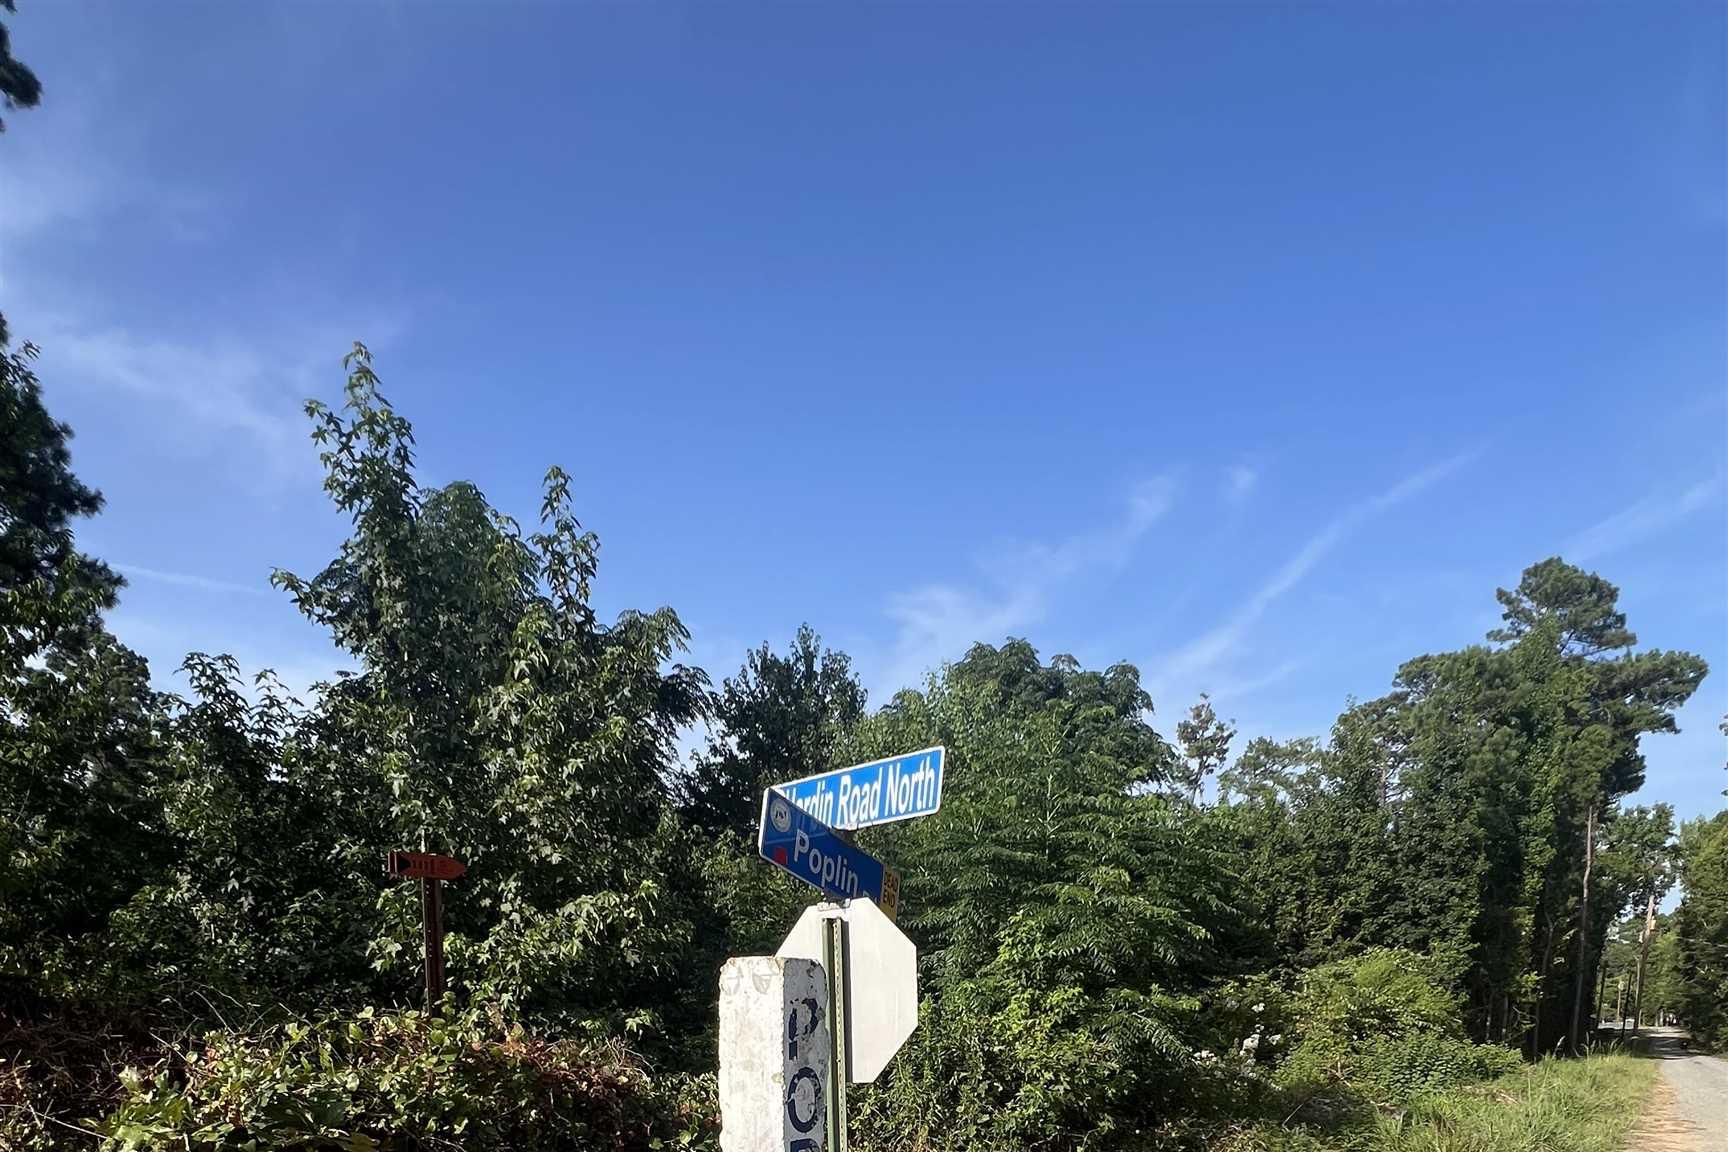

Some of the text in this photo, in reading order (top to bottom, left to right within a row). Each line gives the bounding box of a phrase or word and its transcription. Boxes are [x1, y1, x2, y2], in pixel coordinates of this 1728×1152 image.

[837, 767, 883, 826] Road
[884, 757, 936, 817] North
[794, 829, 859, 898] Poplin
